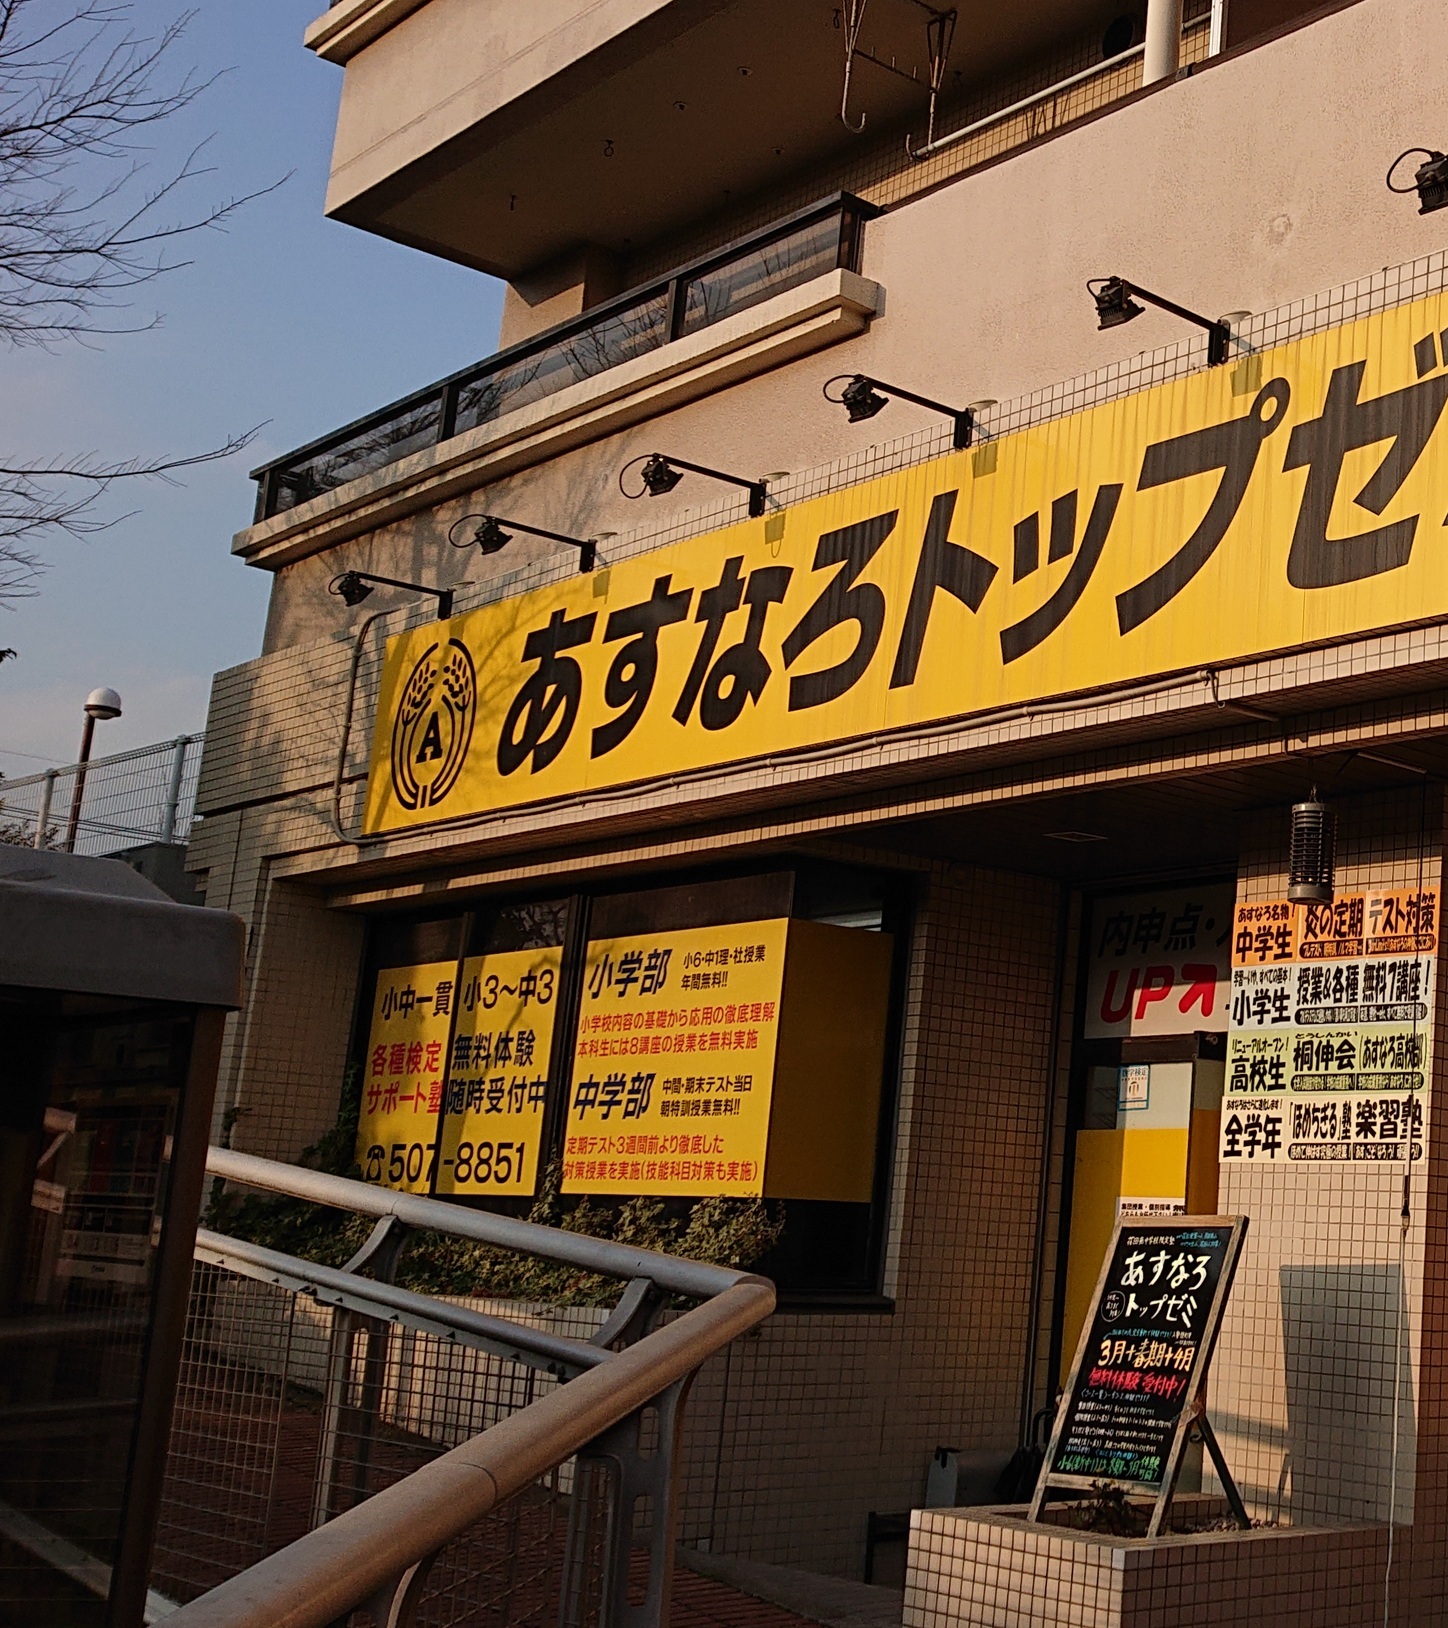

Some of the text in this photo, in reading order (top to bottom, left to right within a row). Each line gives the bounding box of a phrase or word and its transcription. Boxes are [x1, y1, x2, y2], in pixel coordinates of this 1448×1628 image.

[415, 718, 444, 763] A
[1098, 902, 1231, 958] 内申点・
[1235, 922, 1293, 963] 中学生
[586, 947, 674, 1000] 小学部
[680, 971, 729, 992] 年間無料!!
[381, 981, 453, 1021] 小中一貫
[1100, 965, 1175, 1024] UP
[1232, 986, 1292, 1027] 小学生
[579, 1001, 776, 1034] 小学校内容の基礎から応用の徹底理解
[371, 1039, 443, 1077] 各種検定
[452, 1029, 536, 1071] 無料体験
[577, 1028, 759, 1059] 本科生には8講座の授業を無料実施
[1229, 1054, 1287, 1093] 高校生
[1293, 1038, 1357, 1072] 桐伸会
[366, 1080, 444, 1116] サポート塾
[444, 1073, 549, 1116] 随時受付中
[572, 1071, 753, 1121] 中学部 中間・期末テスト当日
[660, 1098, 741, 1118] 朝特訓授業無料!!
[566, 1134, 724, 1156] 定期テスト3週間前より徹底した
[1222, 1113, 1283, 1160] 全学年
[1355, 1098, 1424, 1140] 楽習塾
[1120, 1250, 1213, 1292] あすなろ
[1124, 1292, 1198, 1329] トップゼミ
